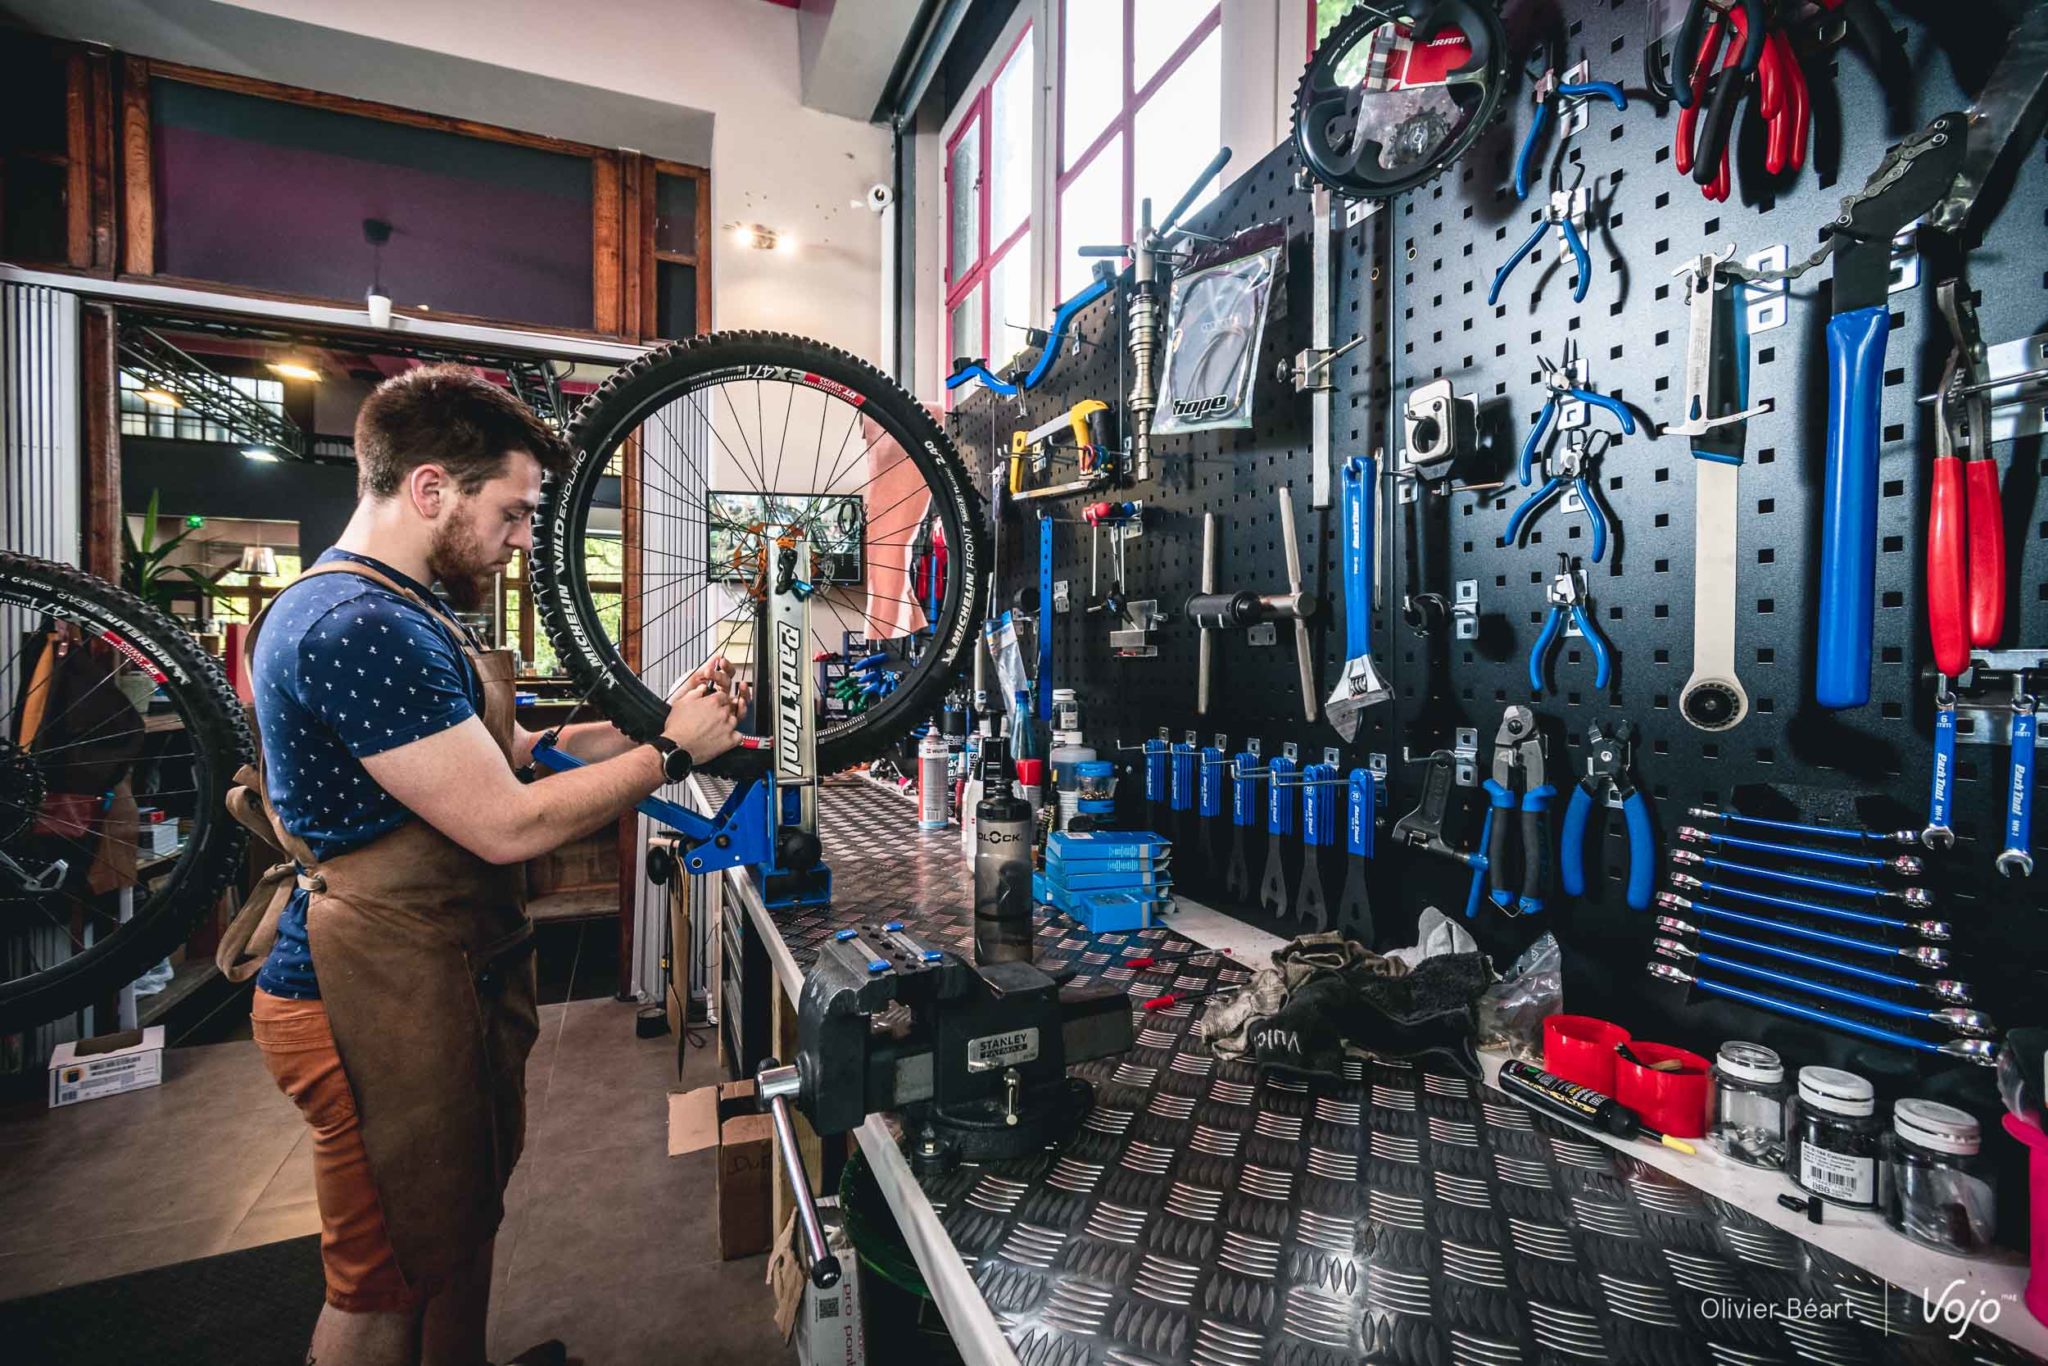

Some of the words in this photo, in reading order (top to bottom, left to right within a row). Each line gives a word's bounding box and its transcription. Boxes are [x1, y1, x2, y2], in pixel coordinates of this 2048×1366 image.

[819, 377, 842, 393] SWISS
[1173, 395, 1228, 418] hope
[924, 440, 946, 466] 2.40
[560, 449, 587, 519] ENDURO
[554, 518, 565, 576] WILD
[962, 526, 977, 569] FRONT
[57, 593, 100, 615] REAR
[951, 572, 975, 647] MICHELIN
[557, 584, 603, 667] MICHELIN
[102, 611, 175, 670] MICHELIN
[119, 640, 146, 664] SWISS
[1940, 715, 1948, 723] 6
[2019, 723, 2027, 732] 7
[980, 1033, 1028, 1051] STANLEY
[843, 1284, 854, 1316] pro
